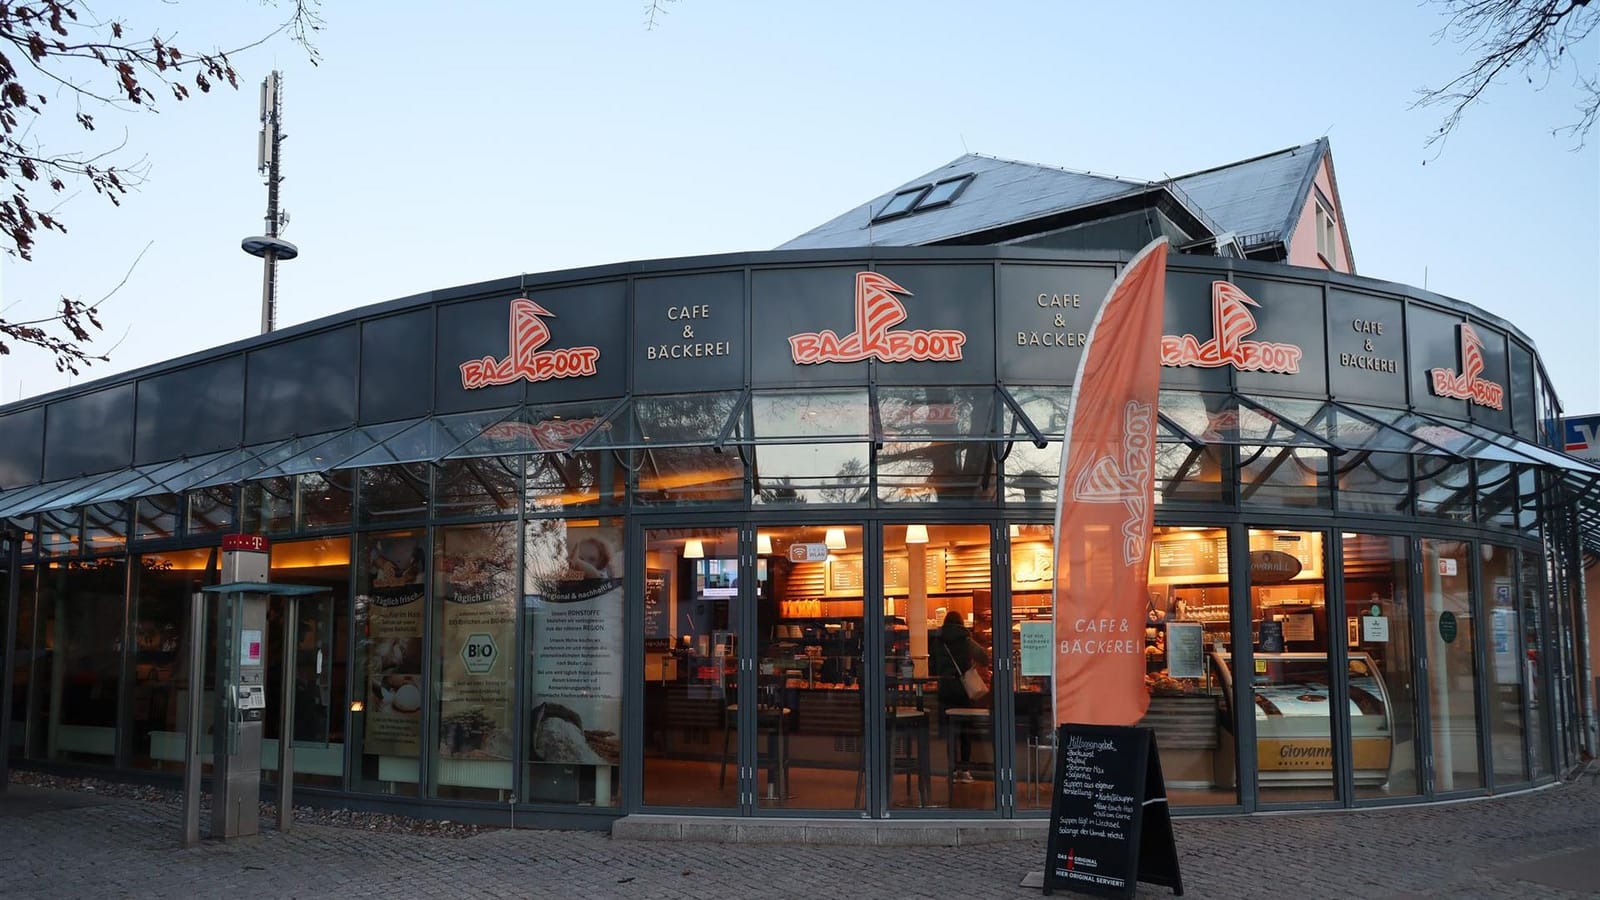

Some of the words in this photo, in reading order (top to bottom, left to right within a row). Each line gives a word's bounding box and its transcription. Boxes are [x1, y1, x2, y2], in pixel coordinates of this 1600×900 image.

[1037, 293, 1081, 308] CAFE
[667, 304, 710, 320] CAFE
[788, 271, 967, 365] BACKBOOT
[1054, 313, 1066, 327] &
[682, 325, 694, 339] &
[1160, 280, 1302, 374] BACKBOOT
[1353, 318, 1384, 336] CAFE
[459, 298, 600, 390] BACKBOOT
[1017, 330, 1087, 347] BÄCKER
[1364, 338, 1374, 352] &
[647, 341, 731, 361] BÄCKEREI
[1340, 352, 1398, 374] BÄCKEREI
[453, 591, 481, 603] Täglich
[578, 582, 613, 598] nachhaltig
[1074, 618, 1115, 633] CAFE
[1119, 618, 1129, 632] &
[1060, 638, 1141, 655] BÄCKEREI
[1280, 743, 1332, 758] Giovann
[1056, 870, 1068, 878] HIER
[1069, 872, 1096, 882] ORIGINAL
